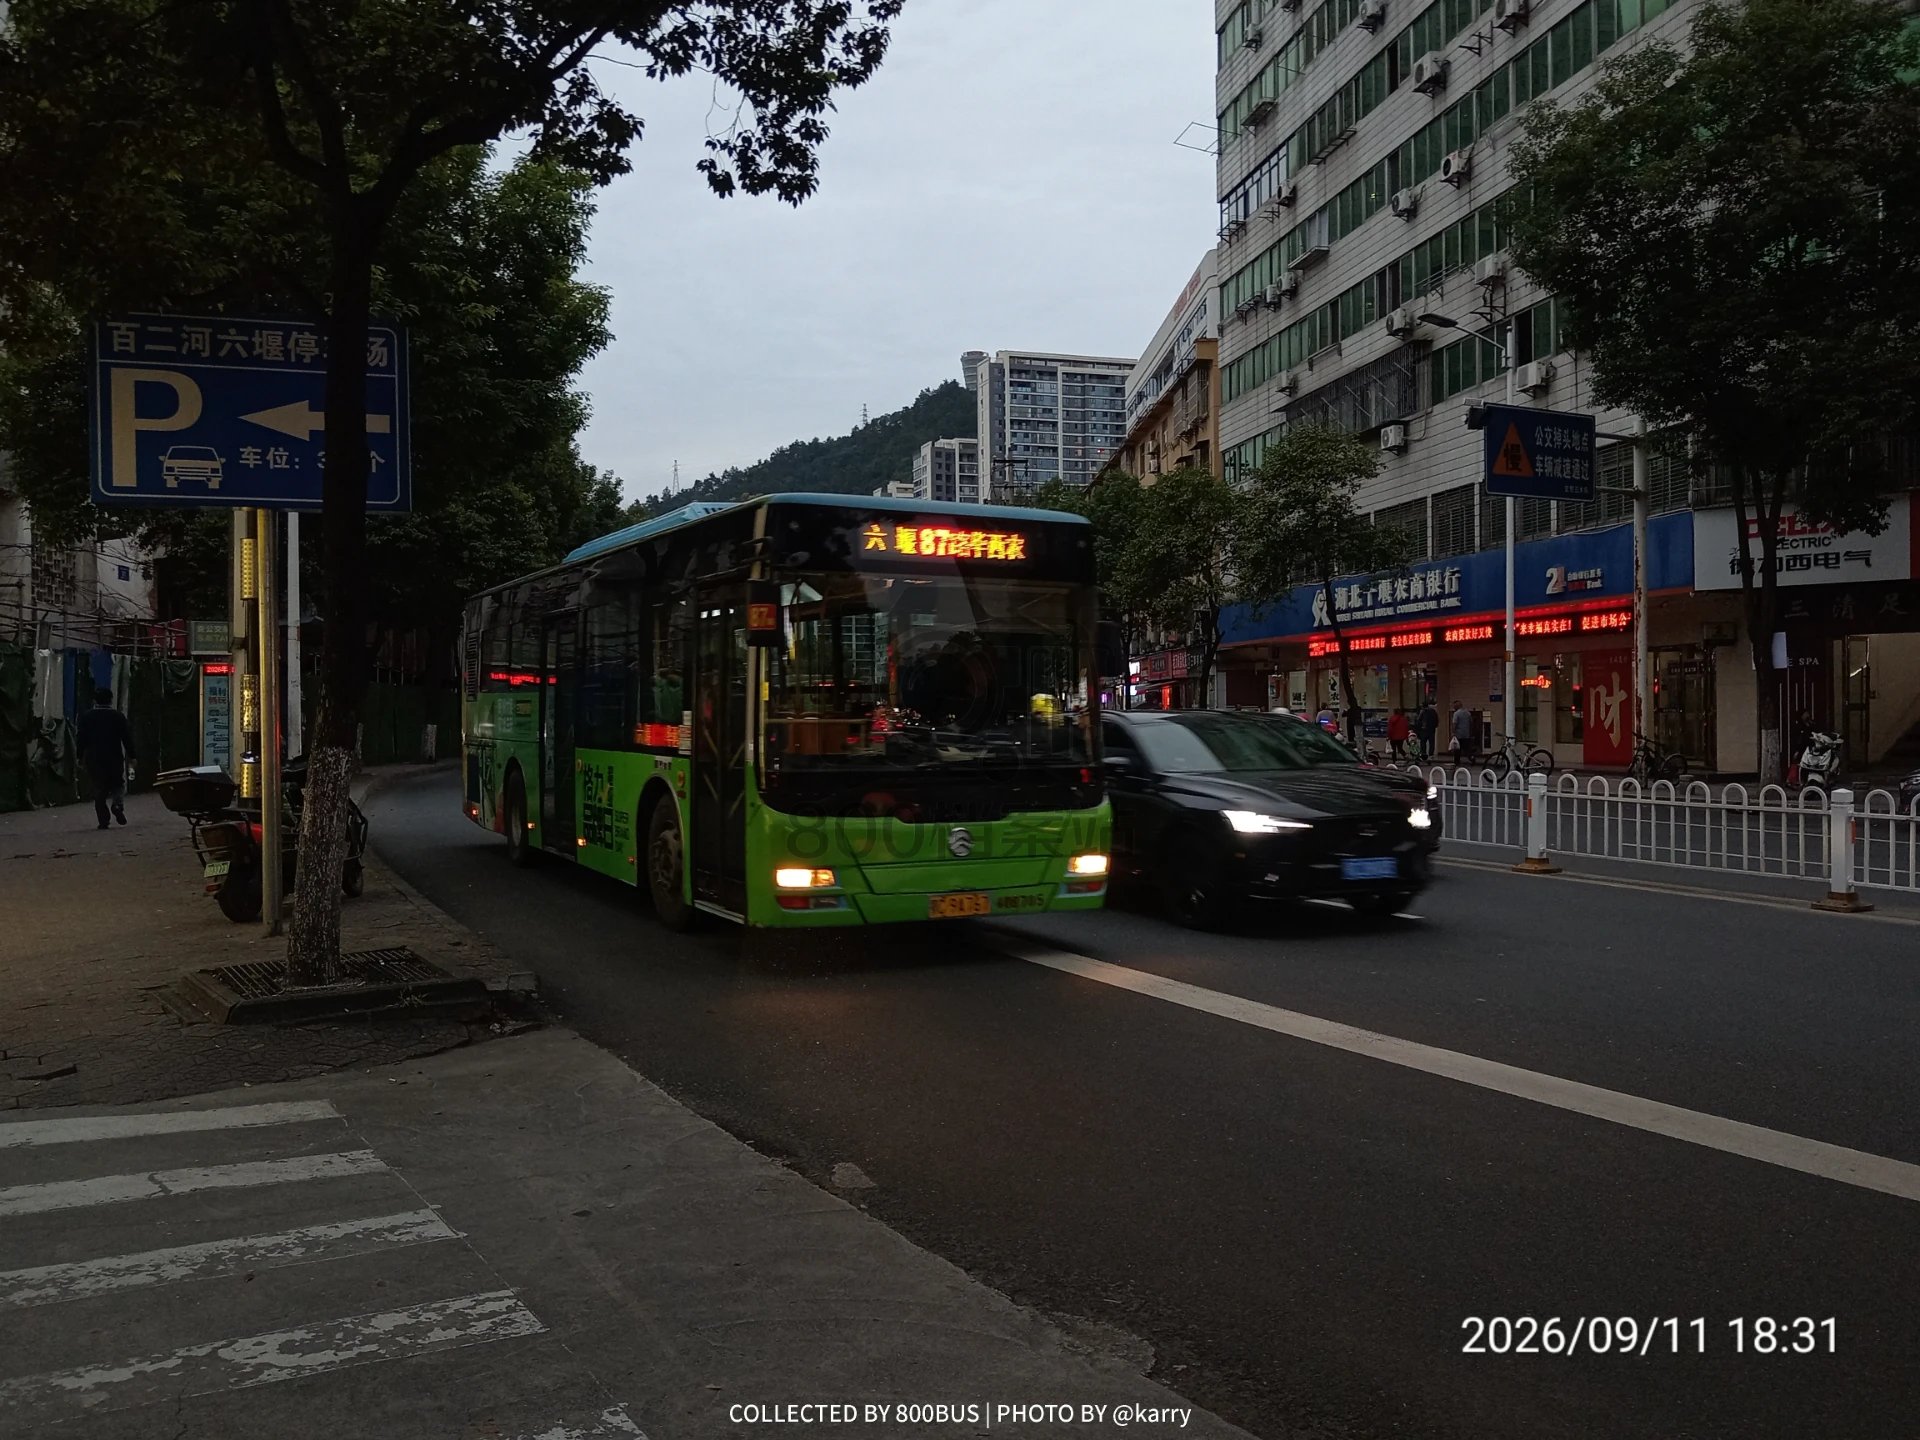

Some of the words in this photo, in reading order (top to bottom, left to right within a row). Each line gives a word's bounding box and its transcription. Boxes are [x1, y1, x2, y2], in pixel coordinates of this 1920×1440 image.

[107, 322, 388, 368] 百二河六堰停场
[111, 367, 203, 487] P
[1535, 425, 1589, 452] 公交掉头地点
[1503, 443, 1522, 472] 慢
[1535, 454, 1590, 481] 车辆减速通过
[1334, 566, 1461, 611] 湖北十堰农商银行
[1397, 600, 1439, 615] COMMERCIAL
[1440, 596, 1462, 608] BANK
[1799, 657, 1820, 666] SPA
[1589, 671, 1628, 749] 财
